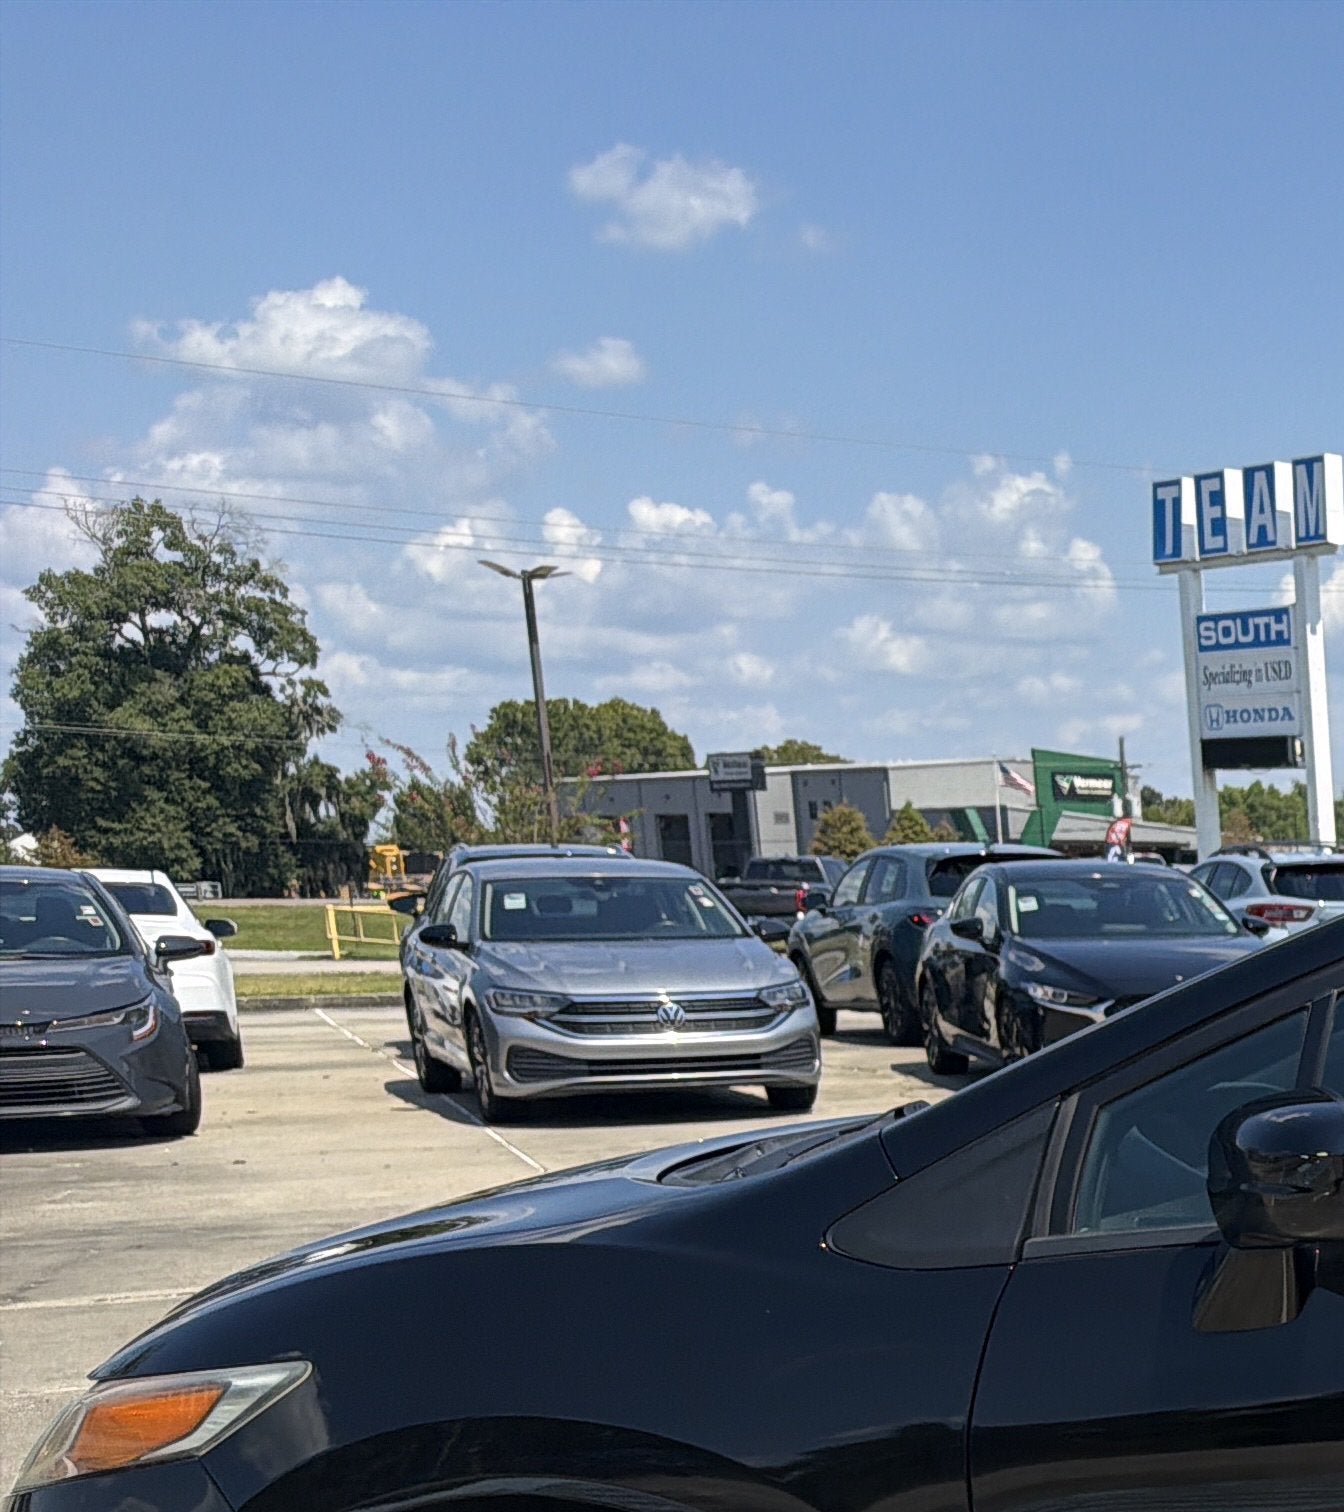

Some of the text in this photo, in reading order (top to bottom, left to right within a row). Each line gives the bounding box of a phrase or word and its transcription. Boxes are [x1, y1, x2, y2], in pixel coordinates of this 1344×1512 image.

[1156, 461, 1324, 556] TEAM
[1199, 614, 1289, 647] SOUTH
[1202, 664, 1253, 691] Specializing
[1264, 659, 1292, 682] USED
[1225, 706, 1295, 724] HONDA
